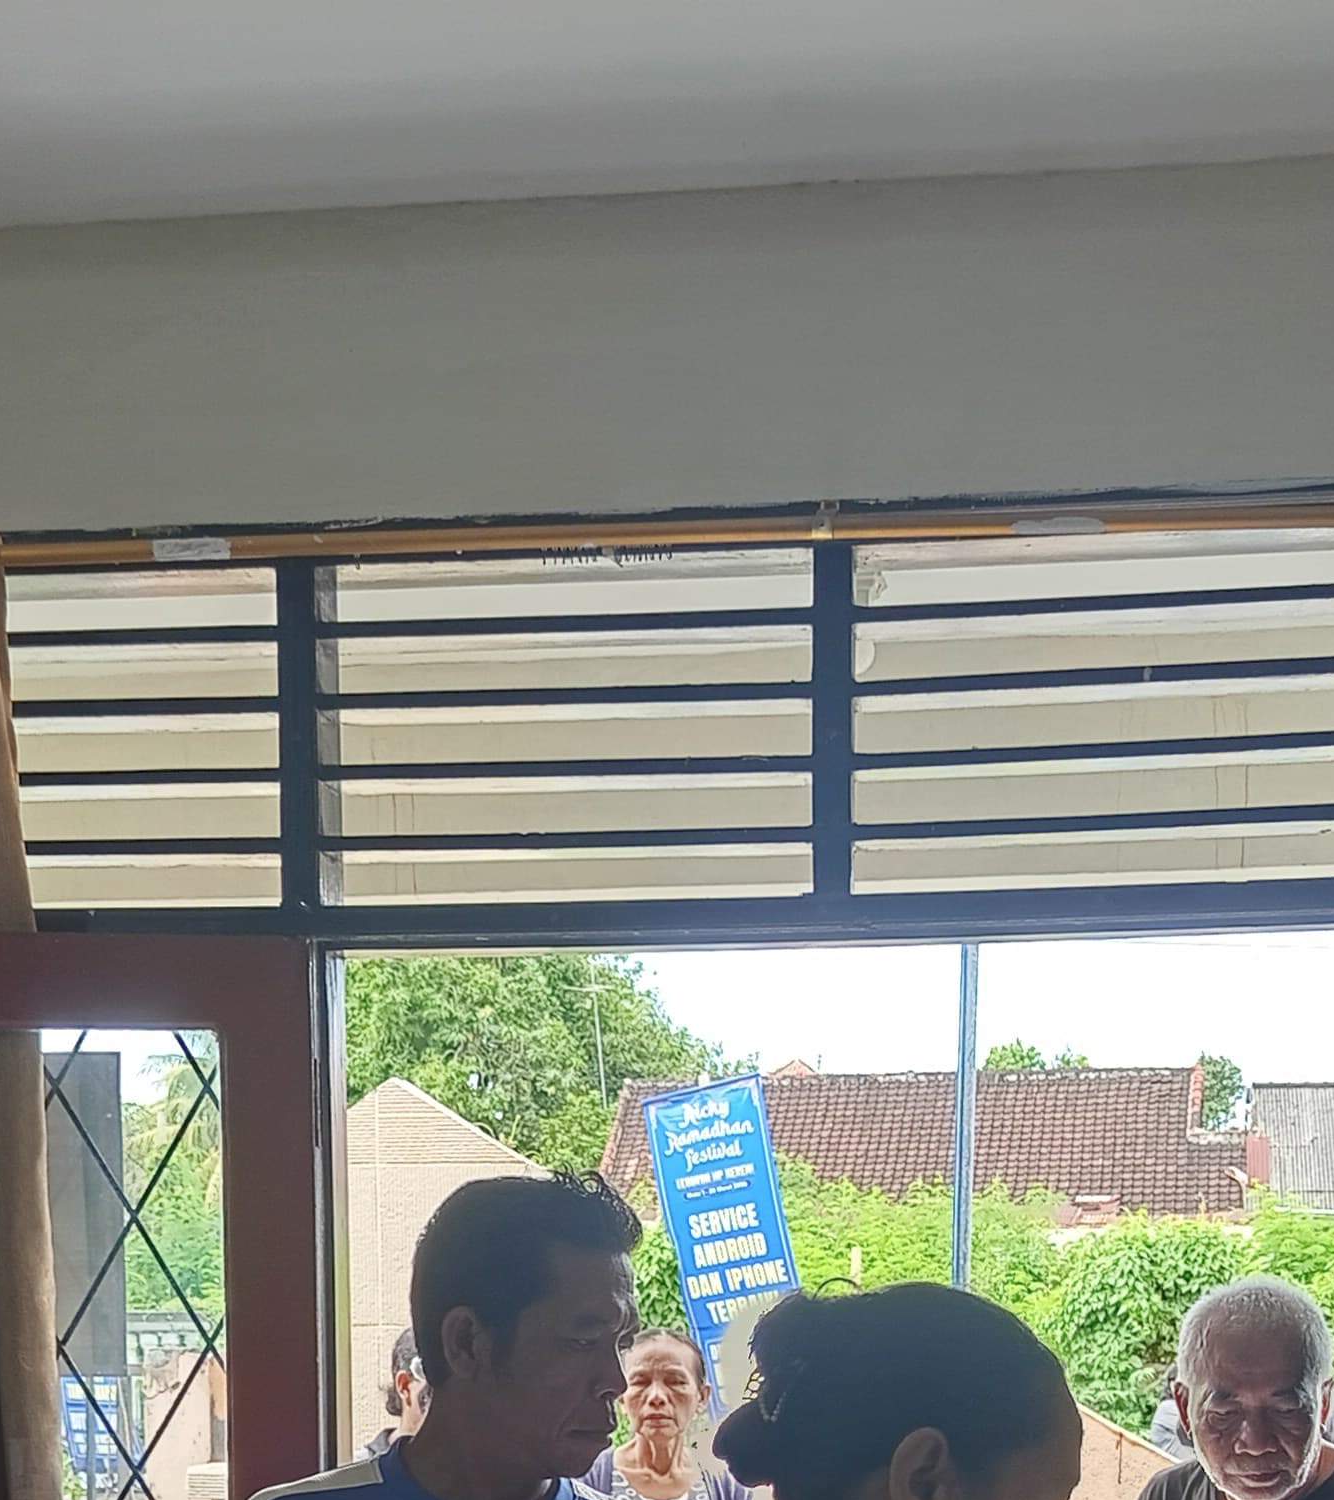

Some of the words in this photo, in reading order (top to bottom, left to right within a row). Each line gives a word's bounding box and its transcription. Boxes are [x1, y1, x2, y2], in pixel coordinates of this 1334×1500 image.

[663, 1119, 755, 1157] Ramadhan
[688, 1202, 759, 1240] SERVICE
[693, 1232, 767, 1269] ANDROID
[686, 1271, 723, 1300] DAN
[725, 1258, 789, 1293] IPHONE
